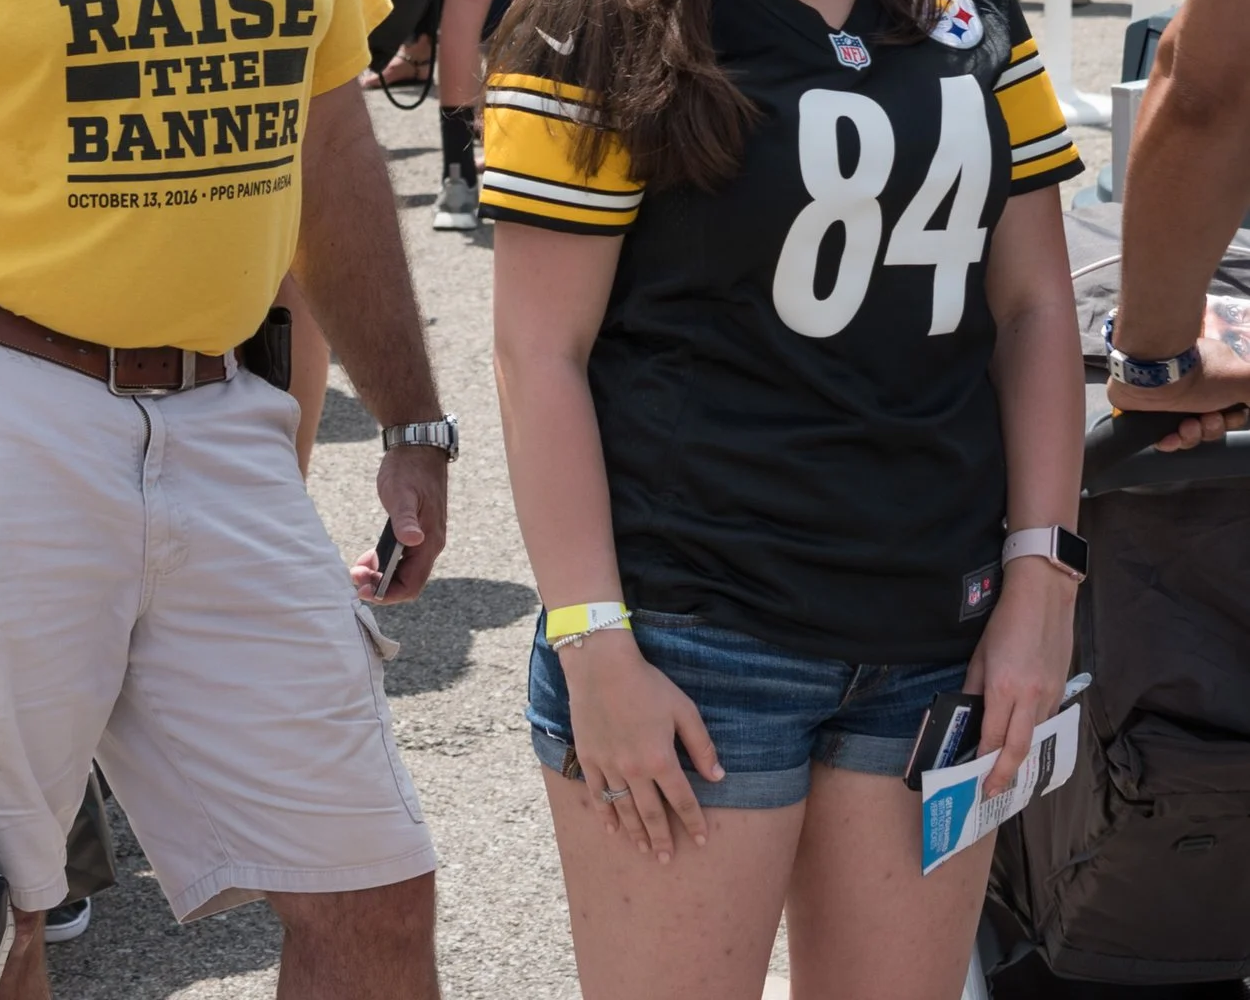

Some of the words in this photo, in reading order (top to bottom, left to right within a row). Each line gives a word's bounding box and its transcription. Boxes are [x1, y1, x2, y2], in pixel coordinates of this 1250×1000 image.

[144, 51, 260, 97] THE
[840, 46, 867, 64] NFL
[67, 99, 299, 163] BANNER
[68, 193, 139, 209] OCTOBER
[142, 193, 162, 209] 13,
[165, 189, 198, 206] 2016
[210, 185, 235, 201] PPG
[237, 179, 272, 198] PAINTS
[772, 74, 988, 338] 84
